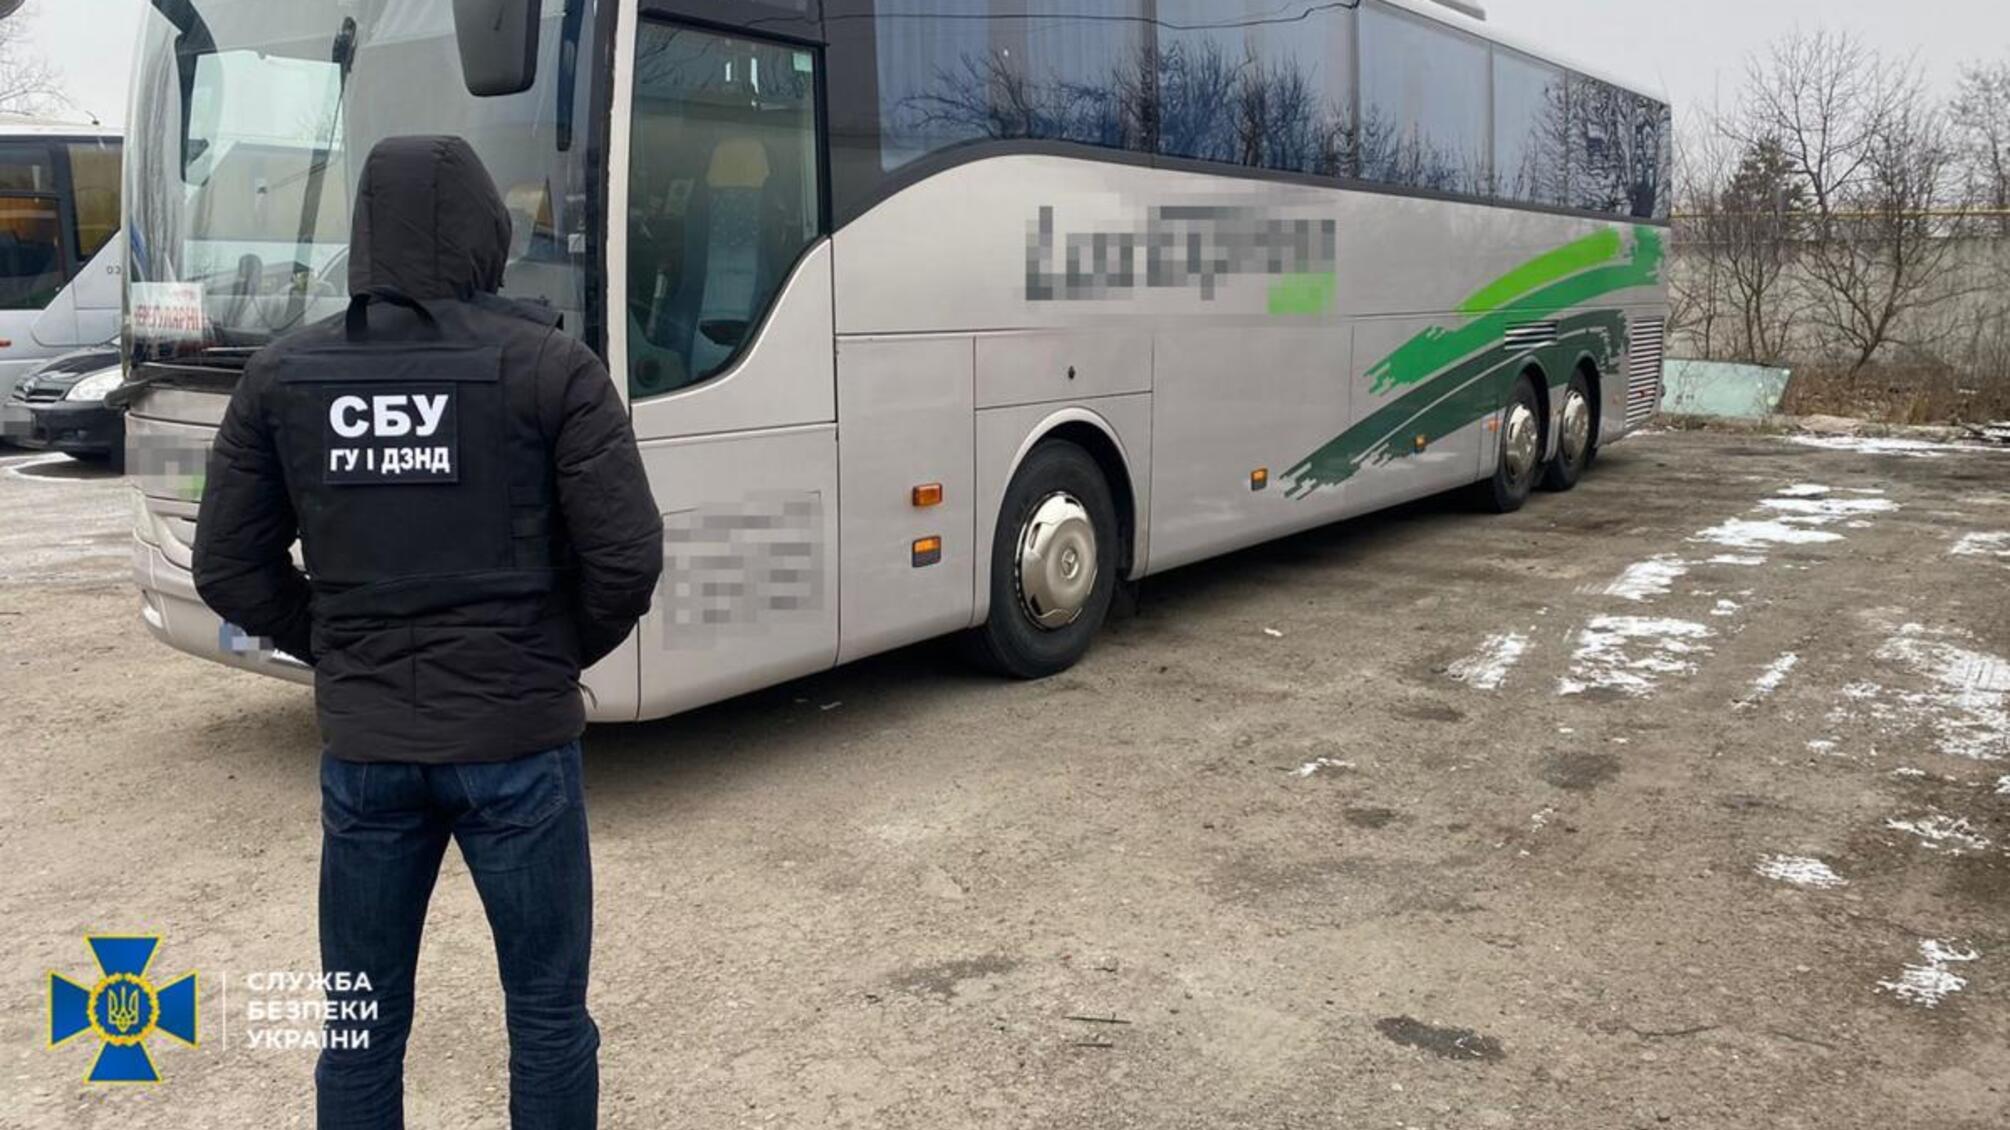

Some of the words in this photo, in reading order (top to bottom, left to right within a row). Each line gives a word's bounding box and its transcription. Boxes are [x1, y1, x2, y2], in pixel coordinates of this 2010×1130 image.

[329, 394, 449, 438] СБУ
[330, 449, 359, 471] ГУ
[367, 448, 374, 470] І
[381, 447, 451, 475] ДЗНД
